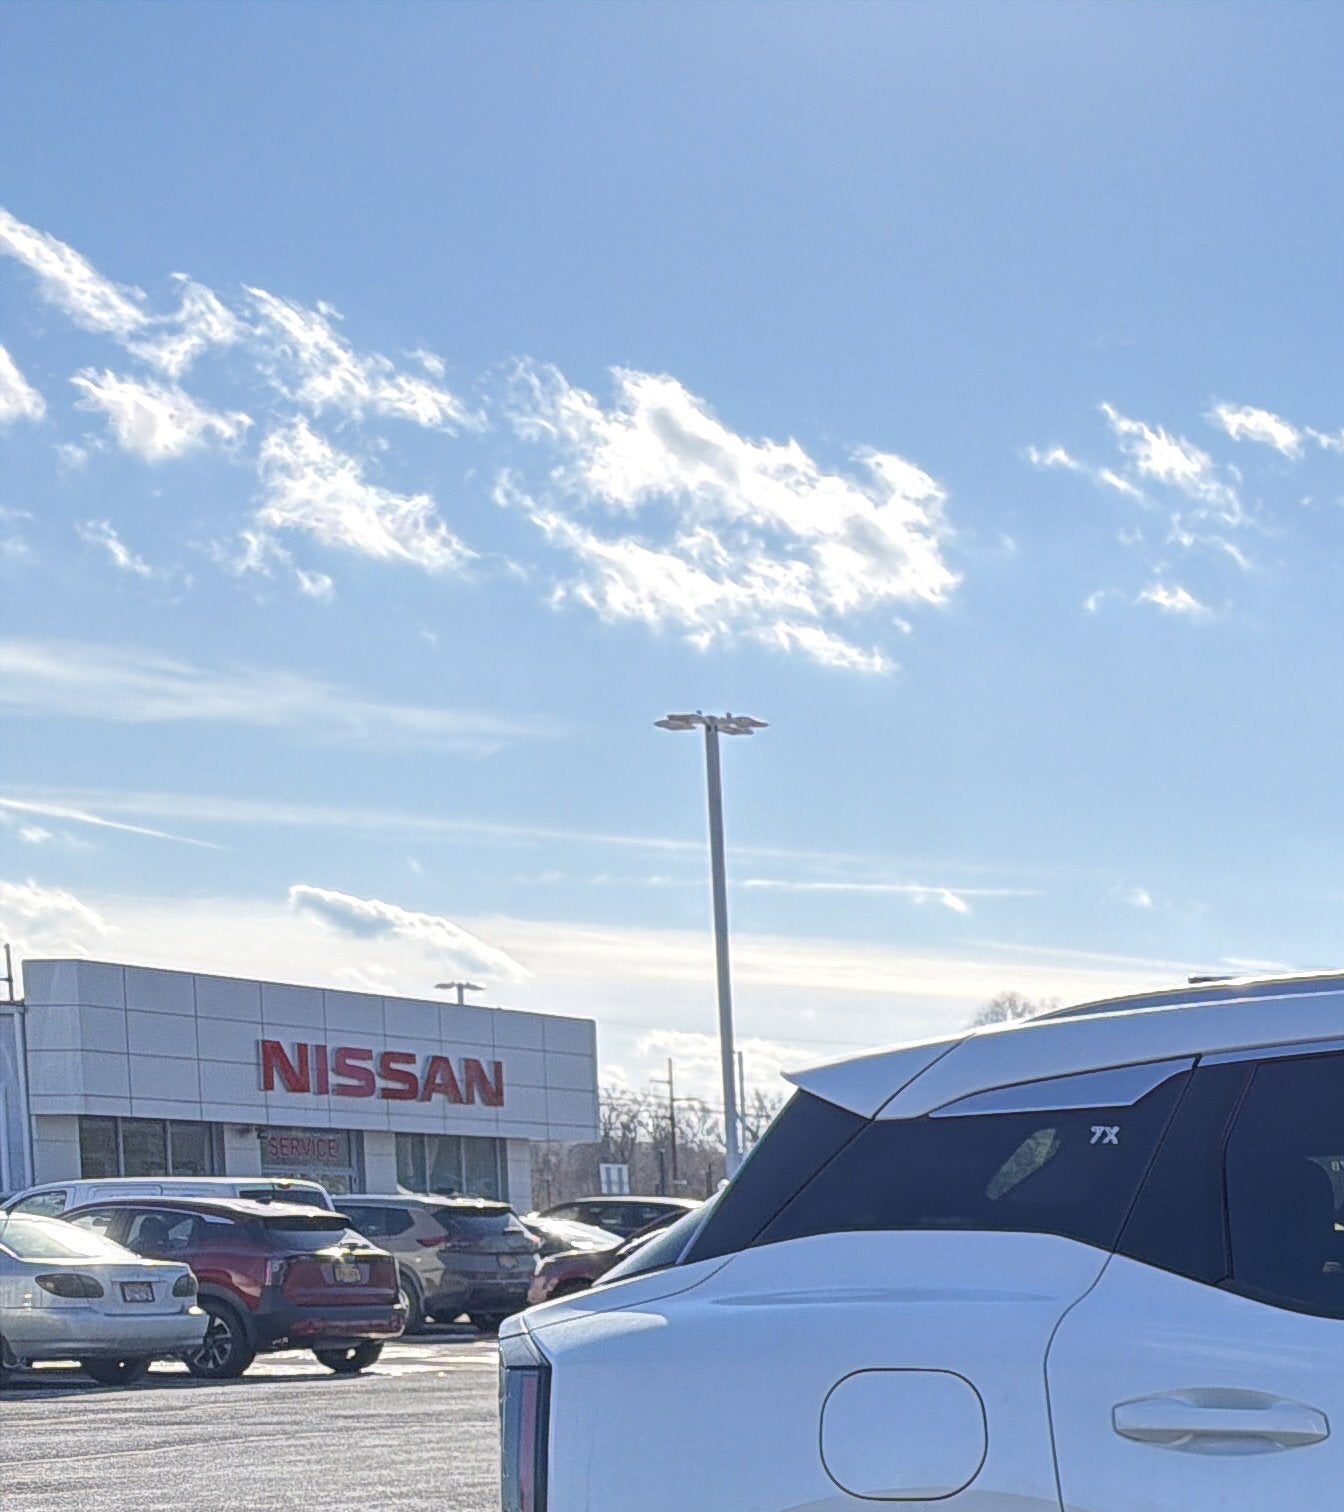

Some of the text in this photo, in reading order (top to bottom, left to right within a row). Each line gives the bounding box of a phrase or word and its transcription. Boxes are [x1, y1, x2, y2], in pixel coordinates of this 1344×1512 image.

[260, 1039, 505, 1107] NISSAN
[1090, 1125, 1120, 1145] 7X
[268, 1136, 338, 1158] SERVICE
